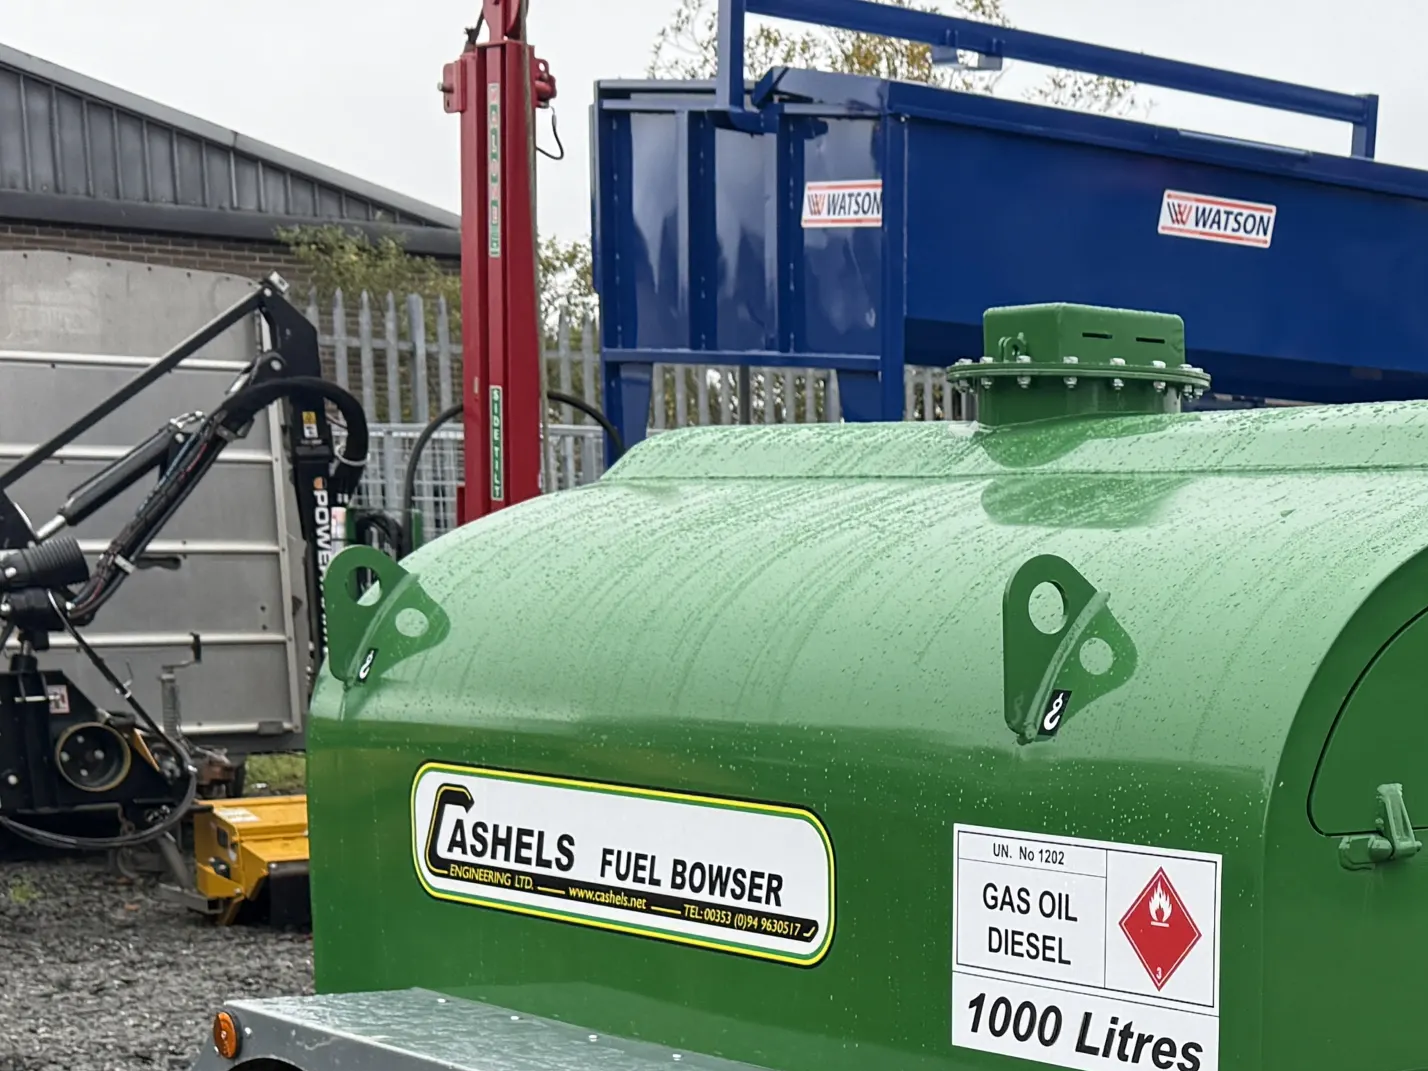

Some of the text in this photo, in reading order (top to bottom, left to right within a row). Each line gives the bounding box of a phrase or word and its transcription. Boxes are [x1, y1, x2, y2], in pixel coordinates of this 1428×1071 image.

[827, 191, 883, 217] WATSON
[1194, 205, 1271, 237] WATSON
[491, 389, 502, 497] SIDE TILT
[312, 490, 332, 582] POWE
[425, 783, 784, 907] CASHELS FUEL BOWSER
[992, 842, 1065, 866] UN. No 1202
[450, 864, 512, 885] ENGINEERING
[515, 875, 534, 891] LTD.
[568, 886, 647, 910] www.cashels.net
[734, 913, 759, 930] (0)94
[760, 916, 801, 937] 9630517
[983, 882, 1078, 923] GAS OIL
[988, 926, 1072, 966] DIESEL
[1155, 966, 1163, 980] 3
[967, 992, 1063, 1048] 1000
